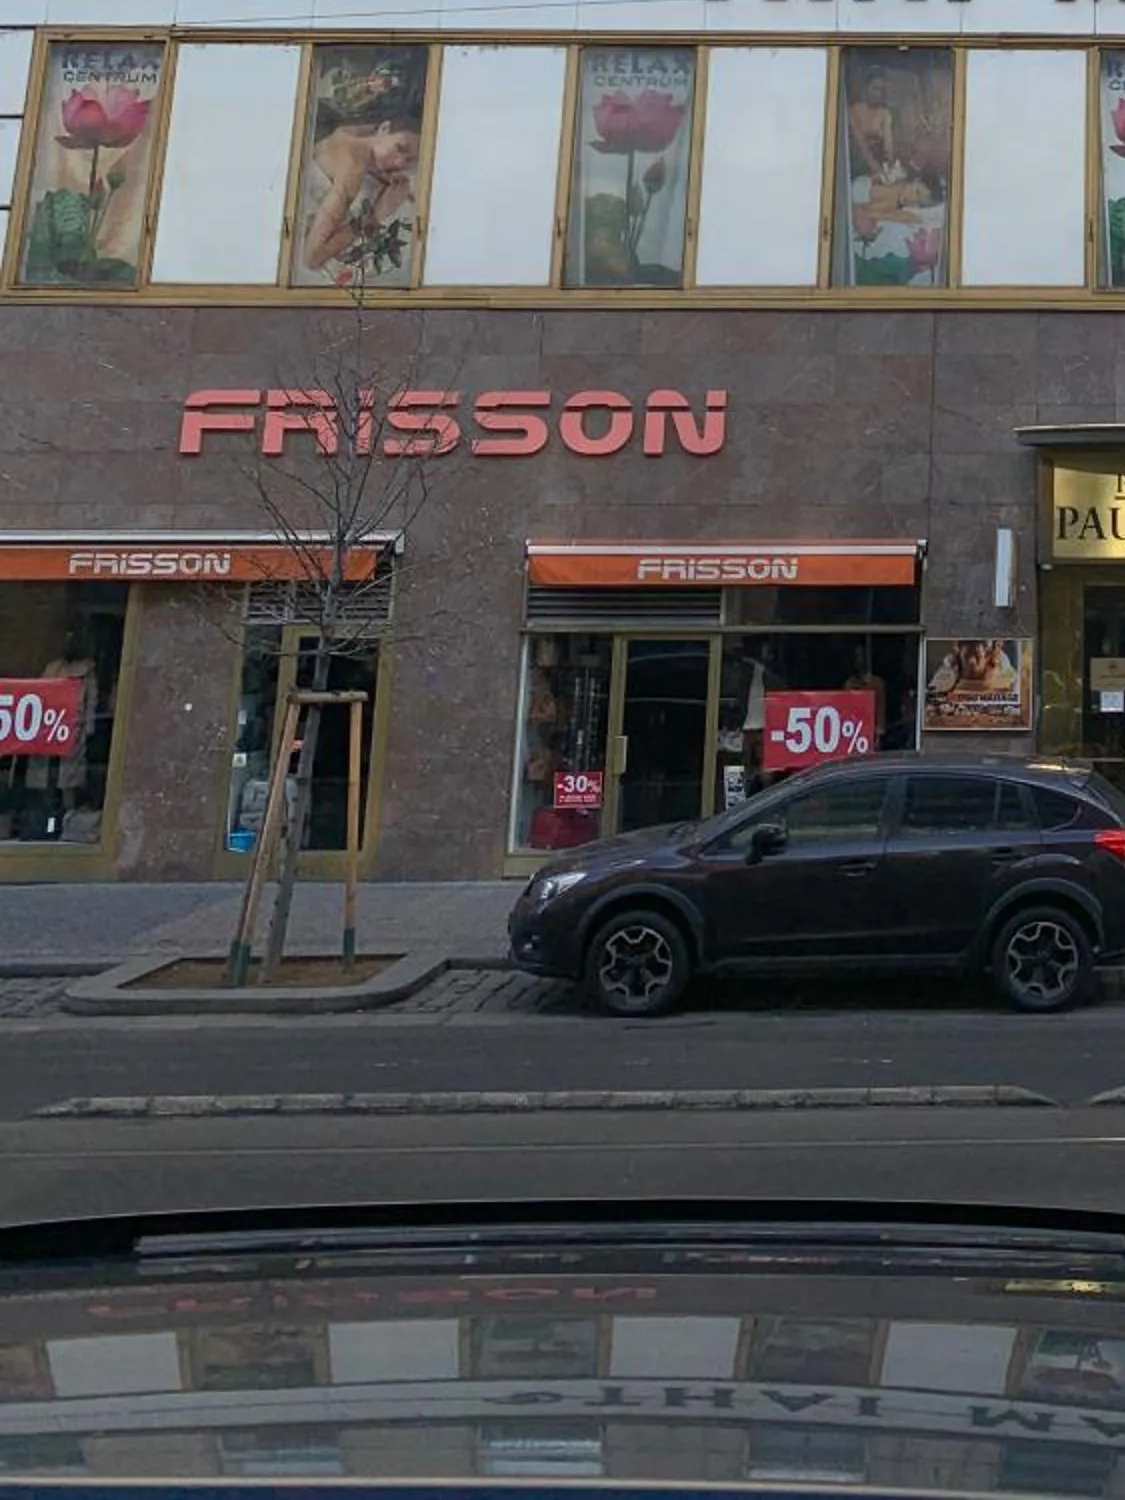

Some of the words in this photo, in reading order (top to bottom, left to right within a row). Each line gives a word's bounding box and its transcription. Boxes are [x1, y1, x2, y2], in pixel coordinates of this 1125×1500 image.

[591, 52, 690, 75] RELAX
[63, 71, 158, 85] CENTRUM
[593, 75, 689, 88] CENTRUM
[178, 389, 727, 456] FRISSON
[69, 552, 231, 575] FRISSON
[637, 558, 798, 580] FRISSON
[771, 706, 869, 754] -50%
